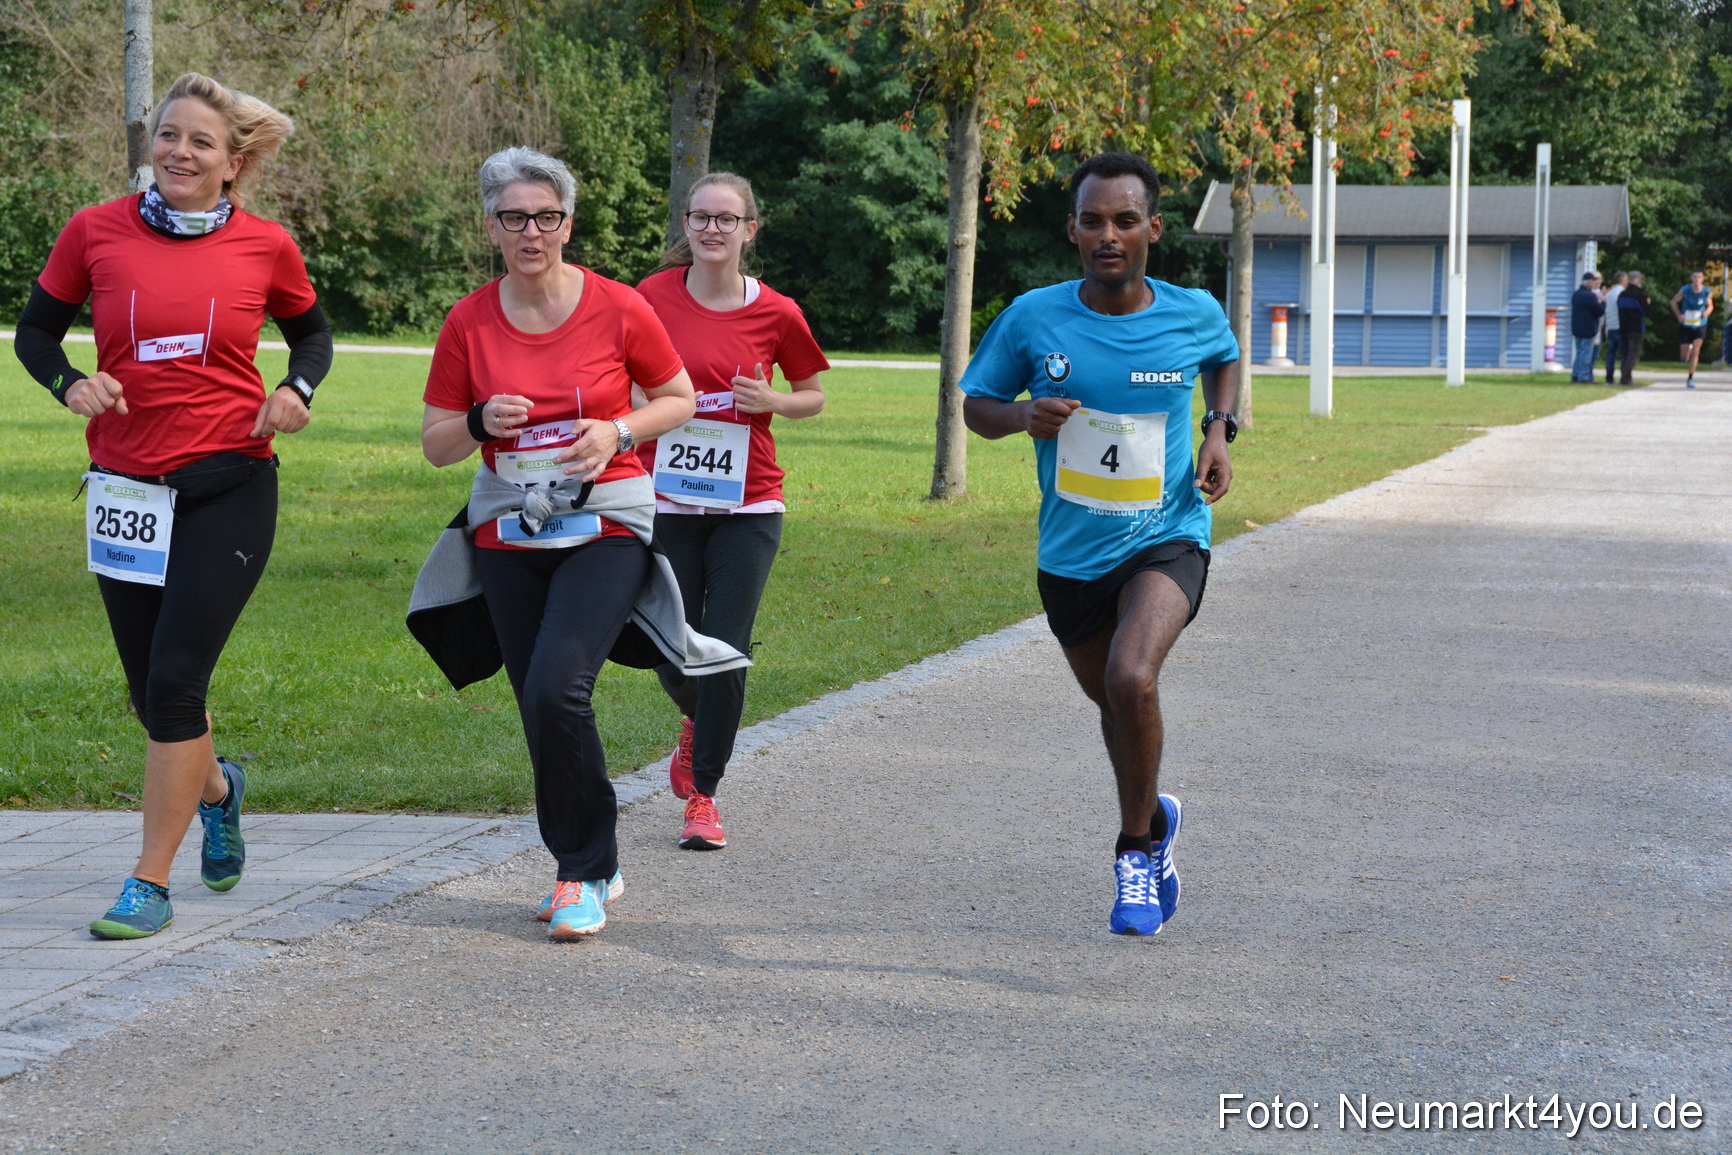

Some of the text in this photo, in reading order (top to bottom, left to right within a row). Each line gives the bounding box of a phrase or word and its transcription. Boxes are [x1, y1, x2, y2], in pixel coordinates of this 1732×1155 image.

[156, 342, 184, 353] DEHN
[1130, 371, 1183, 383] BOCK
[696, 398, 719, 408] DEHN
[693, 427, 723, 437] BOCK
[1100, 420, 1136, 432] BOCK
[533, 427, 560, 440] DEHN
[526, 459, 561, 469] BOC
[668, 443, 733, 475] 2544
[1100, 444, 1120, 473] 4
[113, 485, 147, 498] BOCK
[681, 479, 715, 492] Paulina
[95, 505, 157, 543] 2538
[540, 520, 563, 533] argit
[107, 548, 136, 564] Nadine
